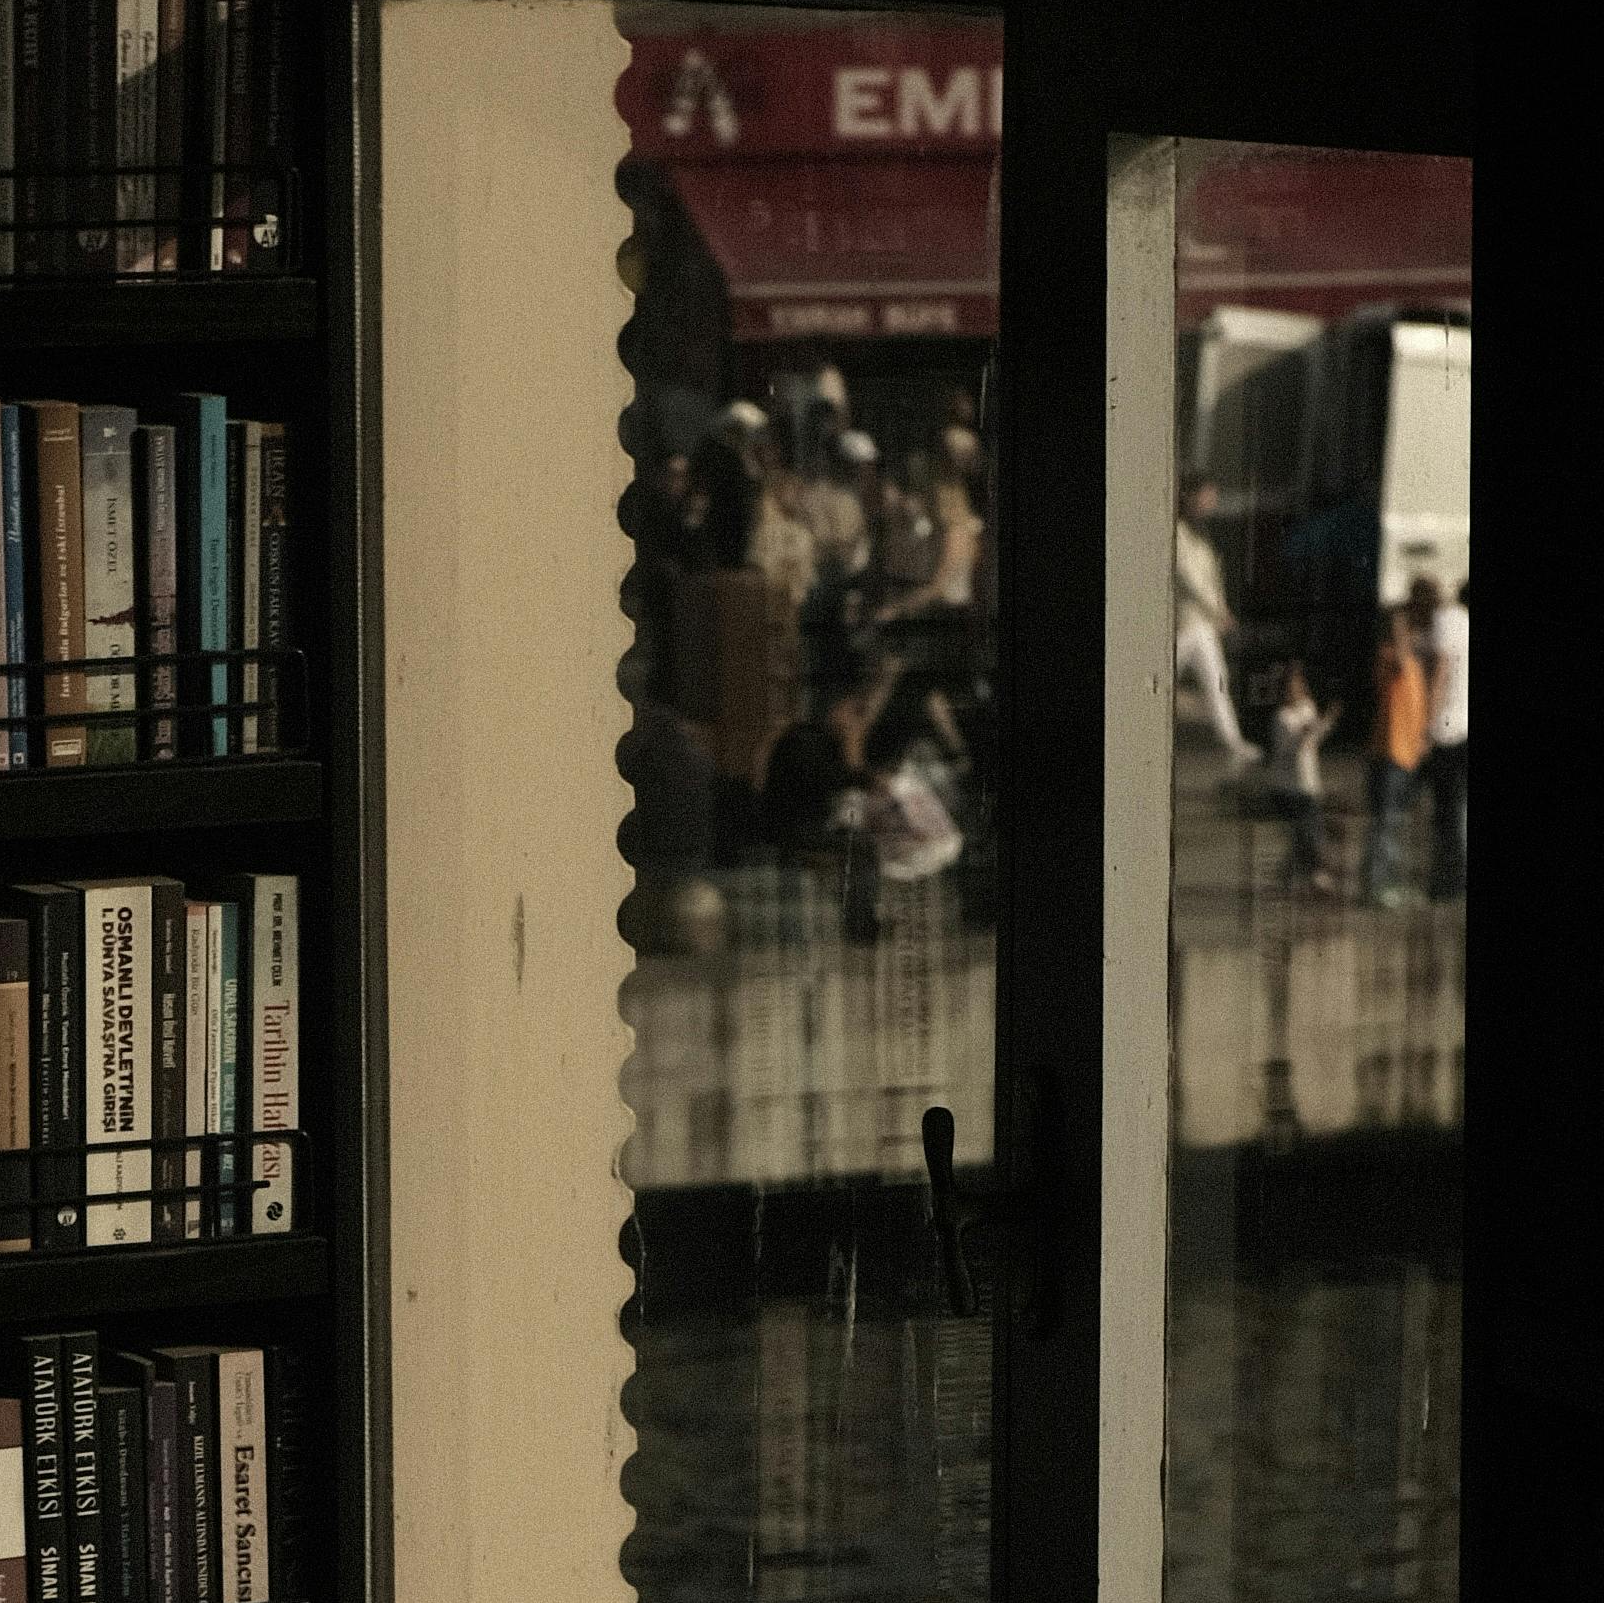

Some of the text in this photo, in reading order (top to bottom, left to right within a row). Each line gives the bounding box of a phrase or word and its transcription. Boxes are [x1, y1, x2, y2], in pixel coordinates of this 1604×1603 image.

[102, 922, 118, 981] DÜNYA
[100, 985, 117, 1079] SAVAŞI'NA
[117, 907, 135, 1132] OSMANLI DEVLETİ'NİN
[101, 1082, 118, 1133] GİRİŞİ
[262, 1000, 290, 1182] Tarihin Hafzası
[33, 1355, 60, 1445] ATATÜRK
[72, 1352, 97, 1442] ATATÜRK
[36, 1454, 62, 1520] ETKİSİ
[74, 1451, 100, 1517] ETKİSİ
[234, 1445, 255, 1516] Esaret
[40, 1547, 60, 1598] SİNAN
[78, 1544, 98, 1597] SİNAN
[236, 1524, 256, 1603] Sancısı
